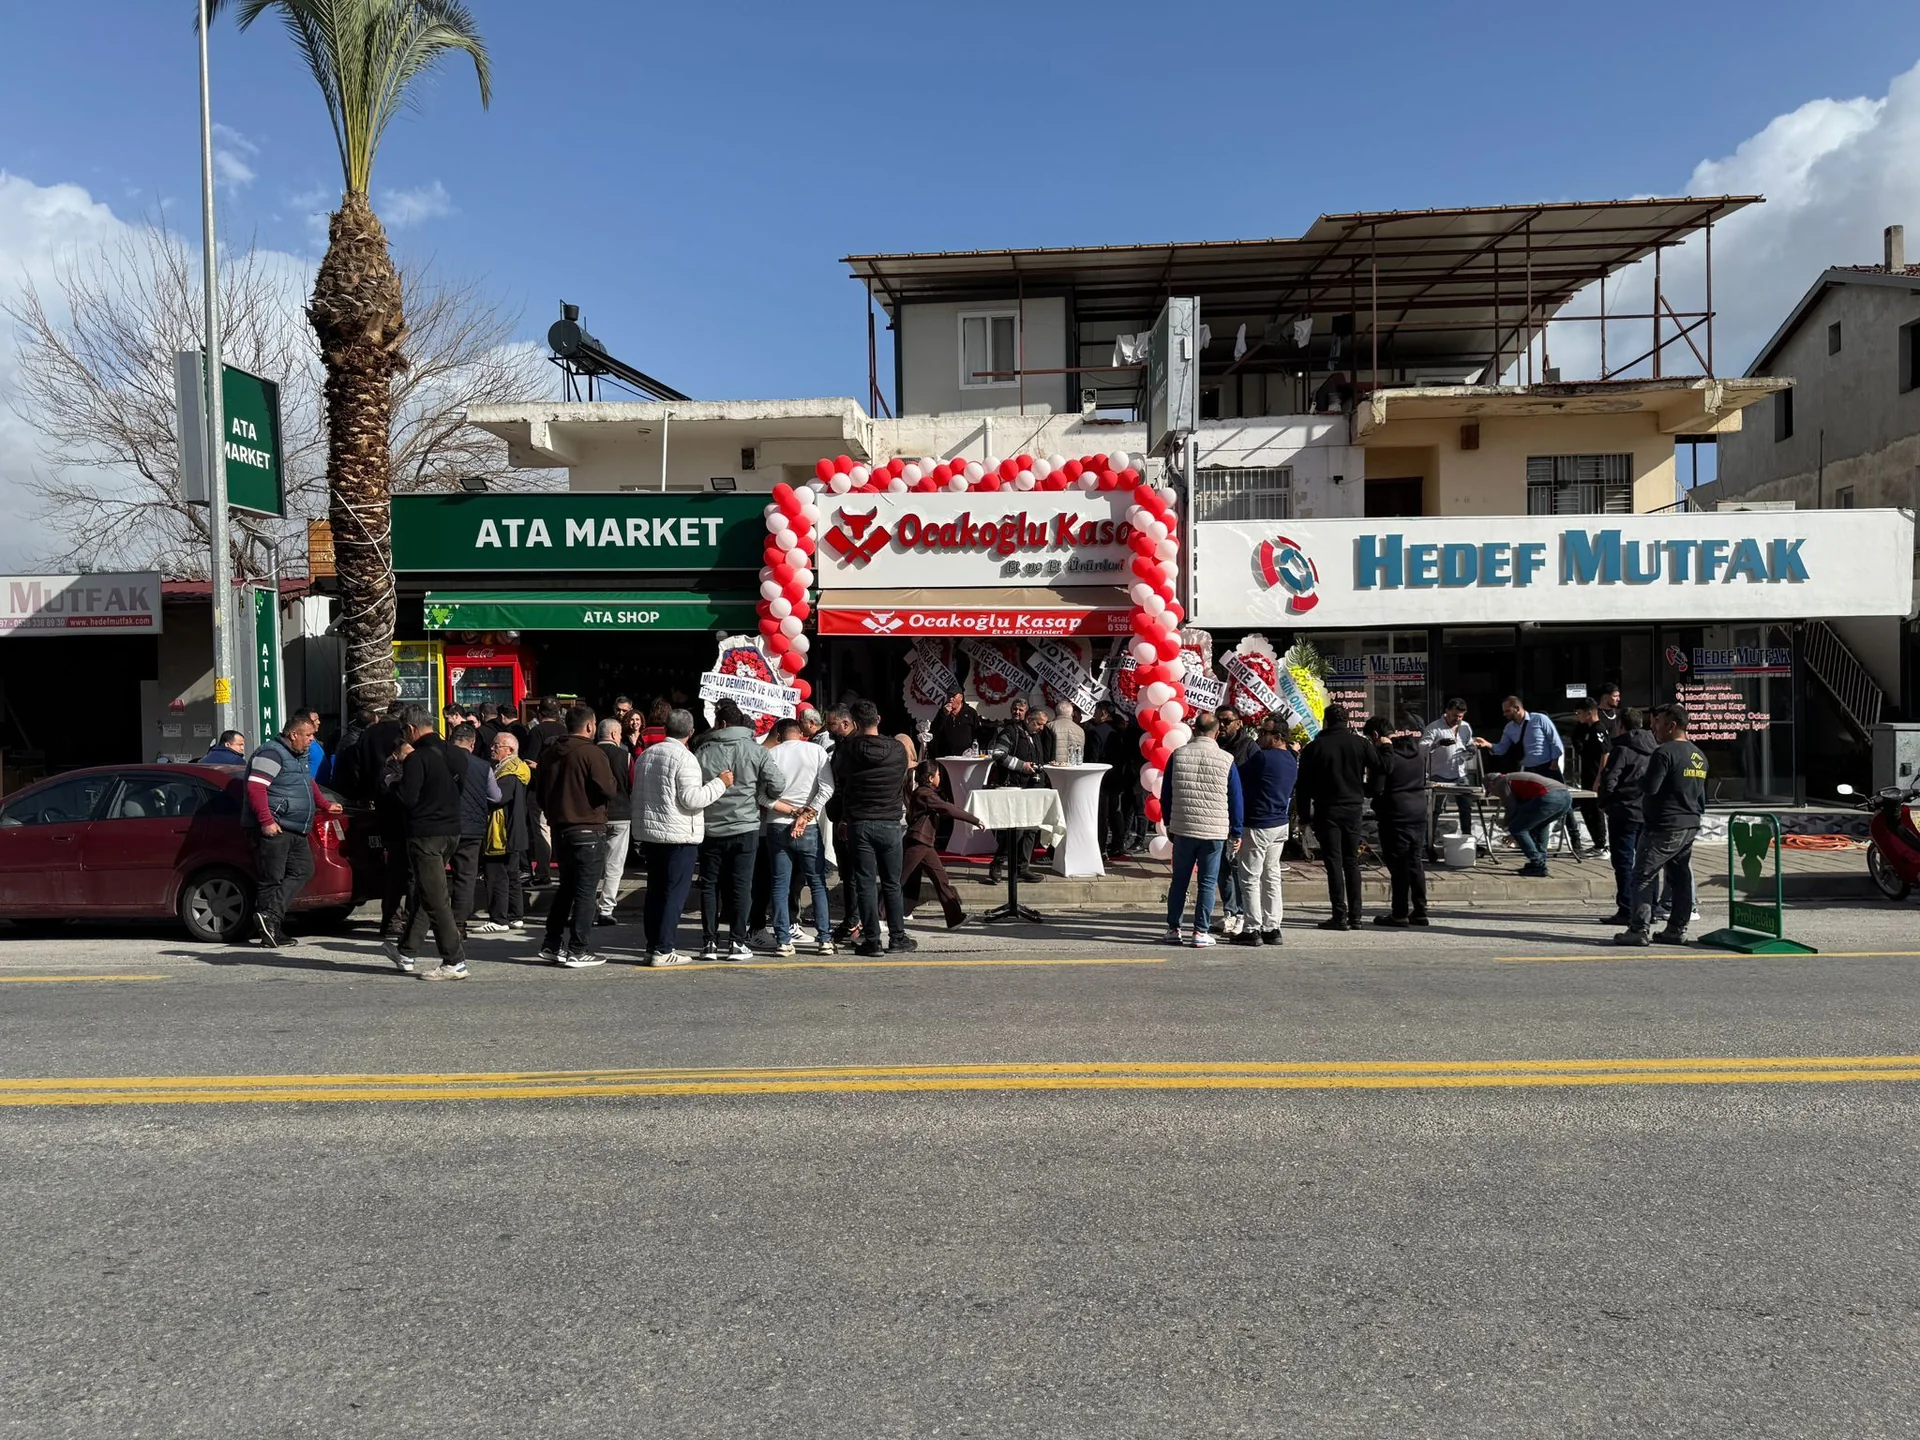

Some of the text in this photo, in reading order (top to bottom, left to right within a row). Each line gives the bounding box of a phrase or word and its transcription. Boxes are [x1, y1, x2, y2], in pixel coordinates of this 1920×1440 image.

[232, 417, 257, 441] ATA
[475, 517, 724, 548] ATA MARKET
[899, 510, 1133, 555] Ocakoğlu Kasa
[1007, 557, 1125, 572] Et ve Et Ürünleri
[1357, 529, 1810, 588] HEDEF MUTFAK
[9, 581, 150, 614] MUTFAK
[90, 617, 150, 626] hedefmutfak.com
[583, 610, 660, 623] ATA SHOP
[909, 613, 1082, 632] Ocakoğlu Kasap
[1108, 623, 1113, 631] 0
[1114, 623, 1128, 631] 539
[262, 643, 270, 688] ATA
[1038, 637, 1080, 676] VOYN
[1081, 673, 1103, 694] TV
[1369, 655, 1424, 672] MUTFAK
[1692, 646, 1791, 665] HEDEF MUTFAK
[979, 649, 1036, 693] RESTAURANT
[703, 674, 724, 687] MUTLU
[757, 684, 766, 695] VE
[1034, 661, 1061, 686] AHMET
[1060, 682, 1096, 716] PATATOĞL
[1189, 674, 1223, 695] MARKET
[1226, 657, 1293, 720] EMRE ARSLAN
[1280, 675, 1296, 697] EKİN
[1290, 695, 1311, 720] ONAT
[1705, 702, 1727, 710] Panel
[1719, 722, 1750, 731] Mobilya
[1735, 906, 1775, 932] Probably
